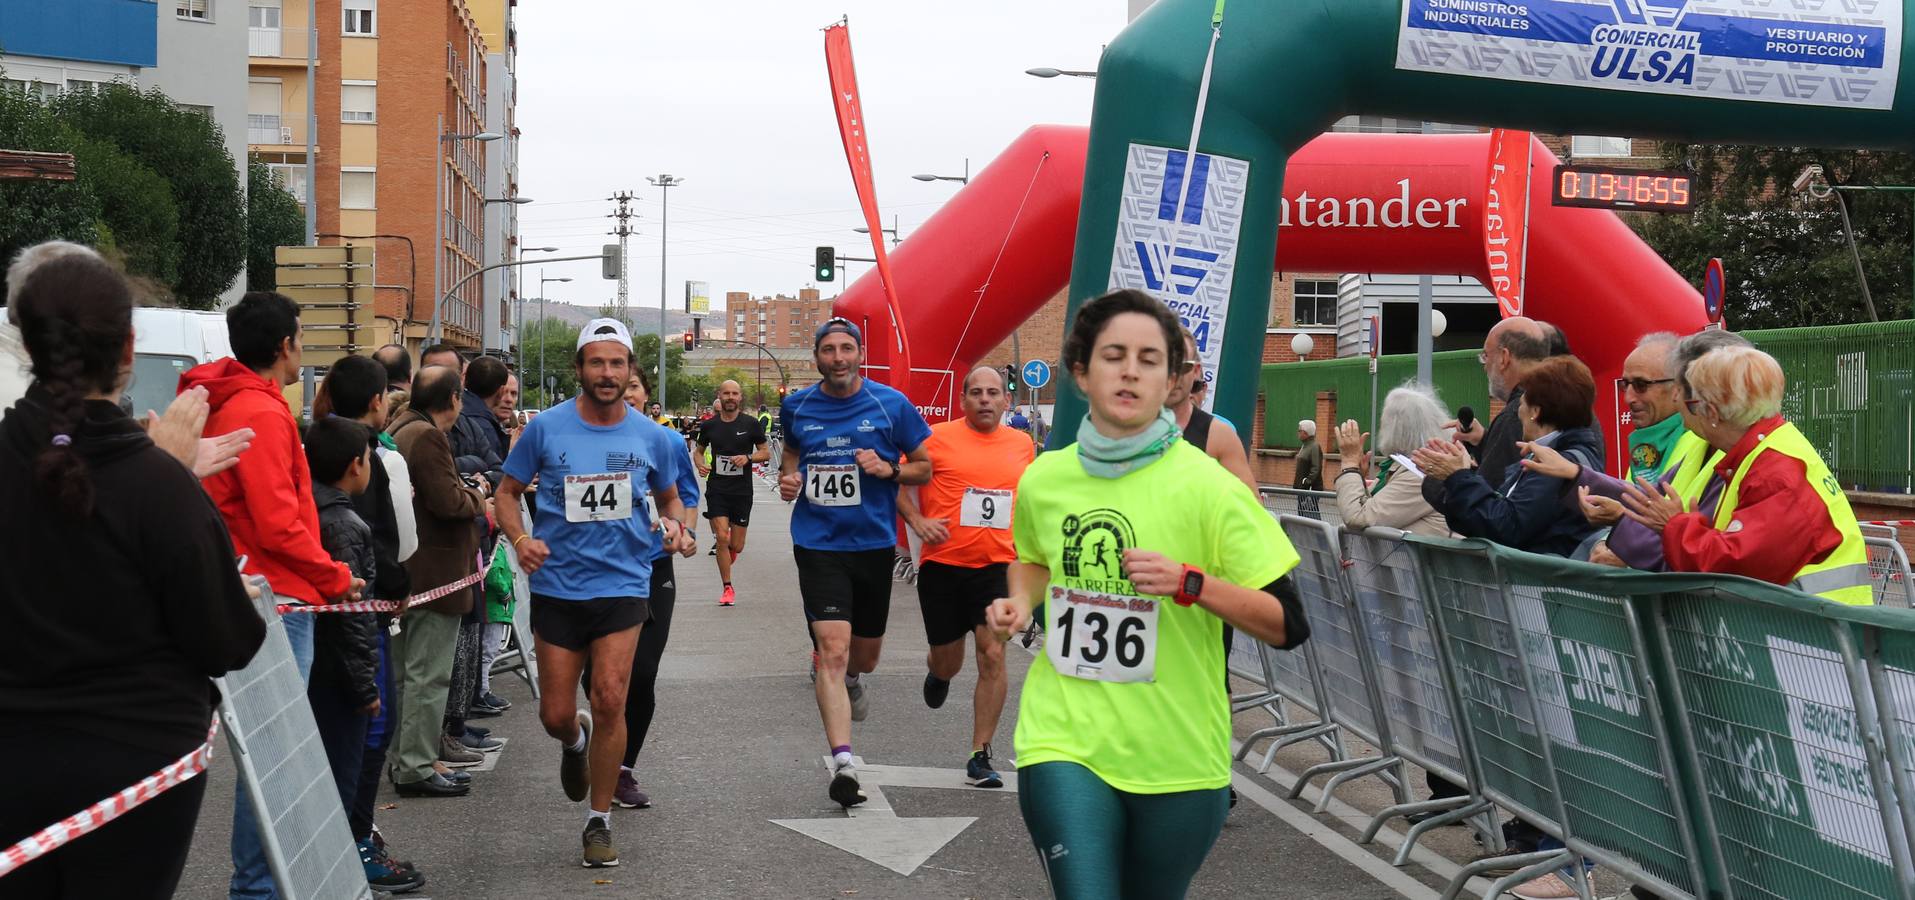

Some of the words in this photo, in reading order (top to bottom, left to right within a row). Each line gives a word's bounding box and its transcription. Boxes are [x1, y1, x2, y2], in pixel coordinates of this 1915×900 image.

[1424, 10, 1530, 31] INDUSTRIALES
[1428, 0, 1528, 17] SUMINISTROS
[1594, 26, 1696, 52] COMERCIAL
[1766, 27, 1854, 44] VESTUARIO
[1857, 33, 1868, 45] Y
[1765, 40, 1866, 60] PROTECCIÓN
[1590, 45, 1695, 86] ULSA
[1561, 171, 1689, 205] 0:13:46:55
[1278, 178, 1467, 230] ntander
[915, 406, 948, 417] orrer
[580, 483, 618, 513] 44
[811, 473, 856, 499] 146
[981, 496, 996, 521] 9
[1064, 577, 1138, 598] CARRERA
[1057, 606, 1146, 669] 136
